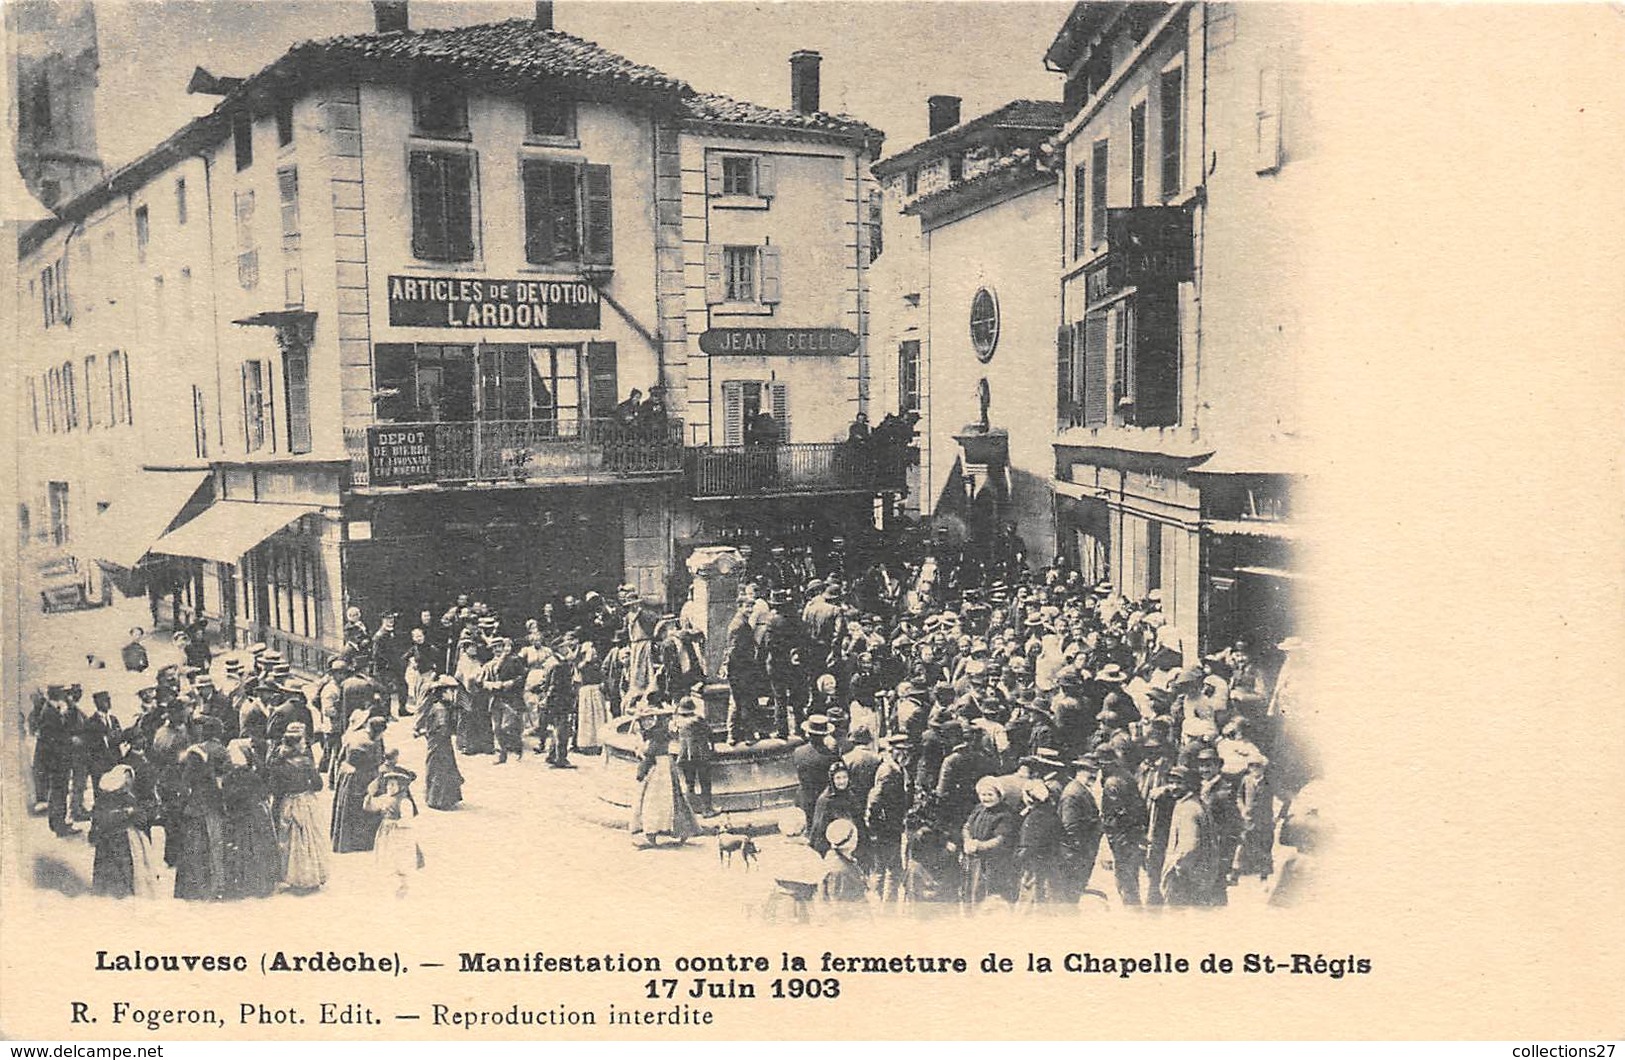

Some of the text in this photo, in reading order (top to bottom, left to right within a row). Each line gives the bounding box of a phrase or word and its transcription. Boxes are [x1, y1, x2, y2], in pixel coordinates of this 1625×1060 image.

[391, 278, 599, 304] ARTICLES DE DEVOTION
[447, 303, 549, 327] LARDON
[719, 332, 767, 350] JEAN
[379, 432, 425, 445] DEPOT
[373, 446, 387, 457] DE
